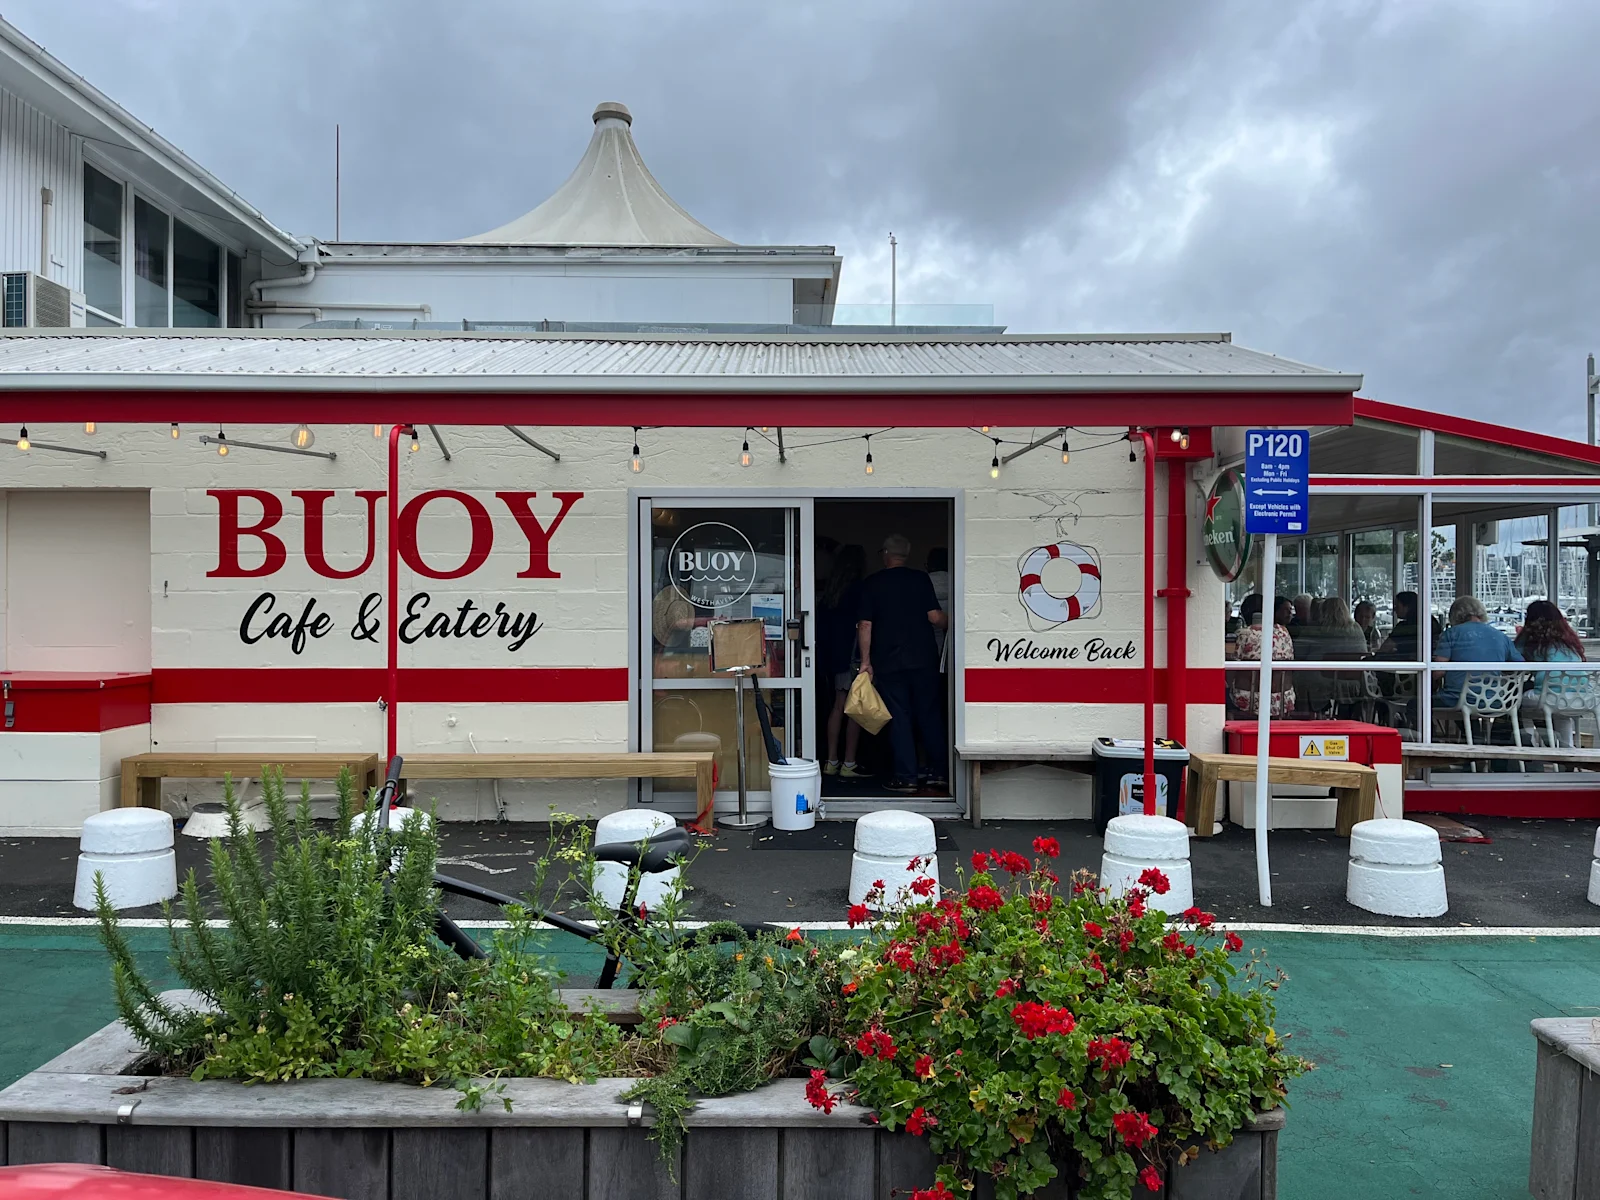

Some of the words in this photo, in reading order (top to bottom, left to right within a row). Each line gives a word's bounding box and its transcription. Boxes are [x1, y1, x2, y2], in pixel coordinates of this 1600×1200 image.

[1250, 434, 1302, 457] P120
[206, 489, 584, 580] BUOY
[1203, 529, 1235, 546] neken
[679, 551, 746, 572] BUOY
[690, 594, 734, 606] WESTHAVEN
[239, 592, 334, 655] Cafe
[350, 592, 382, 644] &
[398, 591, 544, 652] Eatery
[986, 637, 1081, 662] Welcome
[1083, 637, 1137, 662] Back
